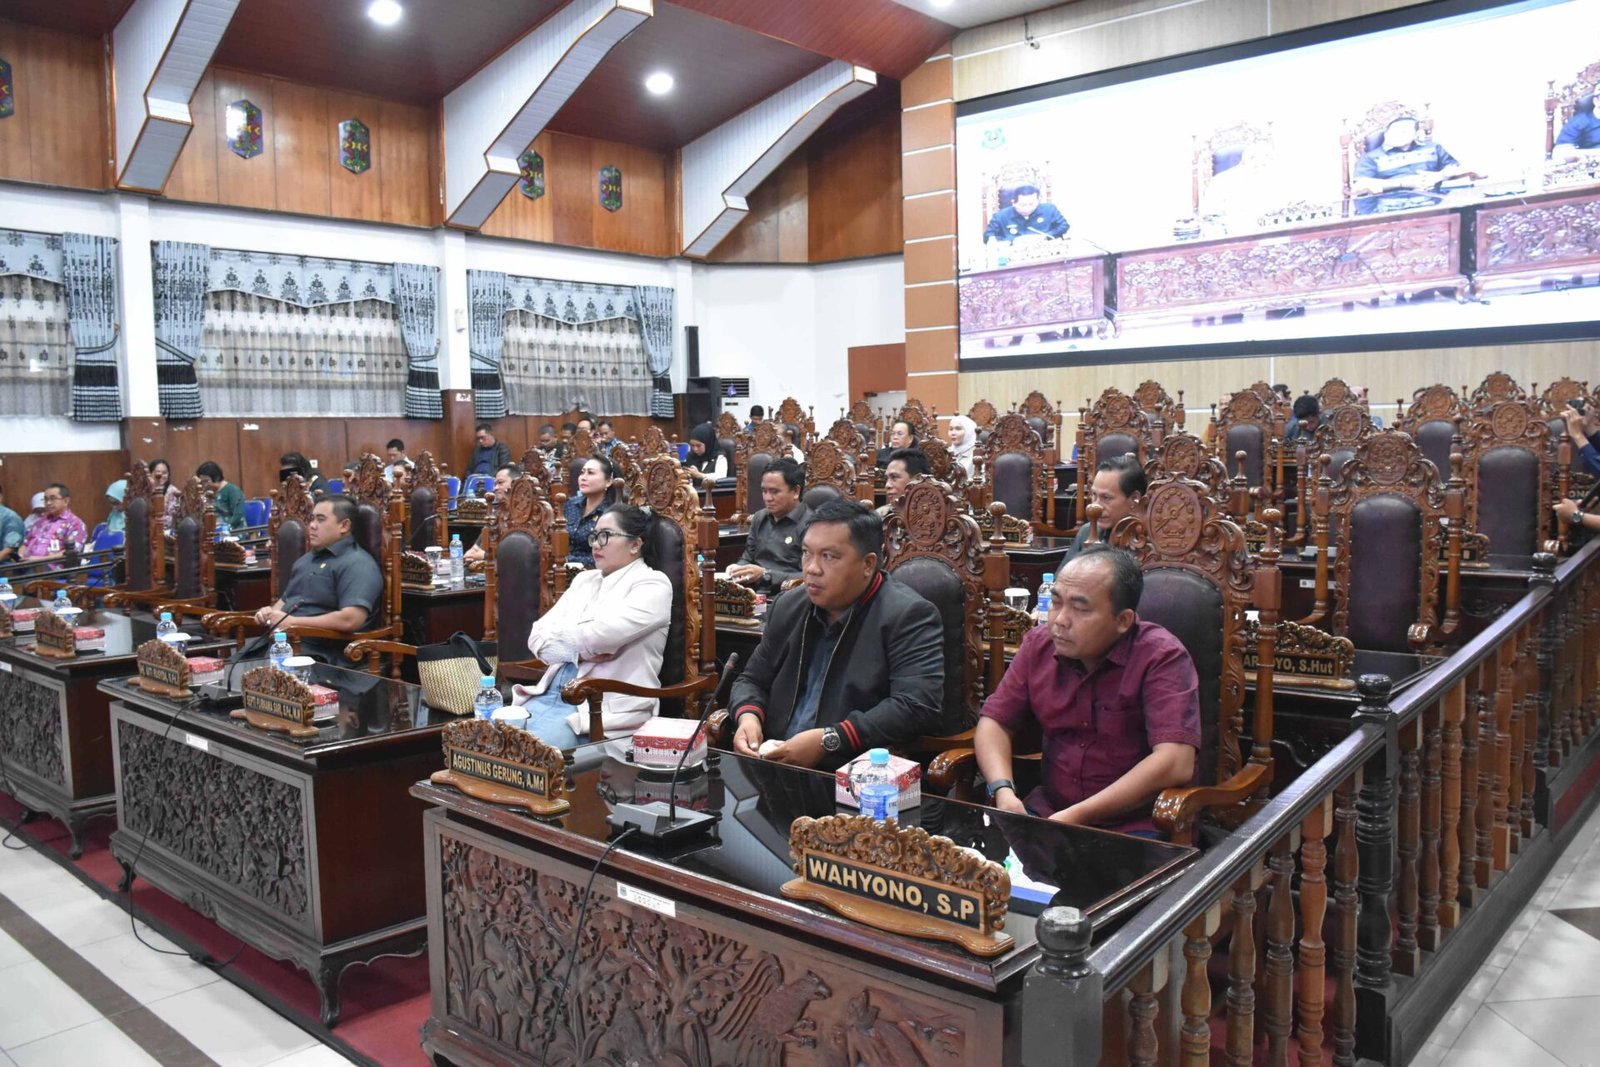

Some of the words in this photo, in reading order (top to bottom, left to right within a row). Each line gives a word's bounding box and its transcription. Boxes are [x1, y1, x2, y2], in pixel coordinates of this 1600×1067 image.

[1298, 659, 1333, 674] S.Hut
[453, 754, 492, 775] AGUSTINUS
[492, 764, 525, 788] GERUNG,
[526, 774, 544, 791] A.Md
[809, 858, 929, 914] WAHYONO,
[936, 893, 975, 921] S.P
